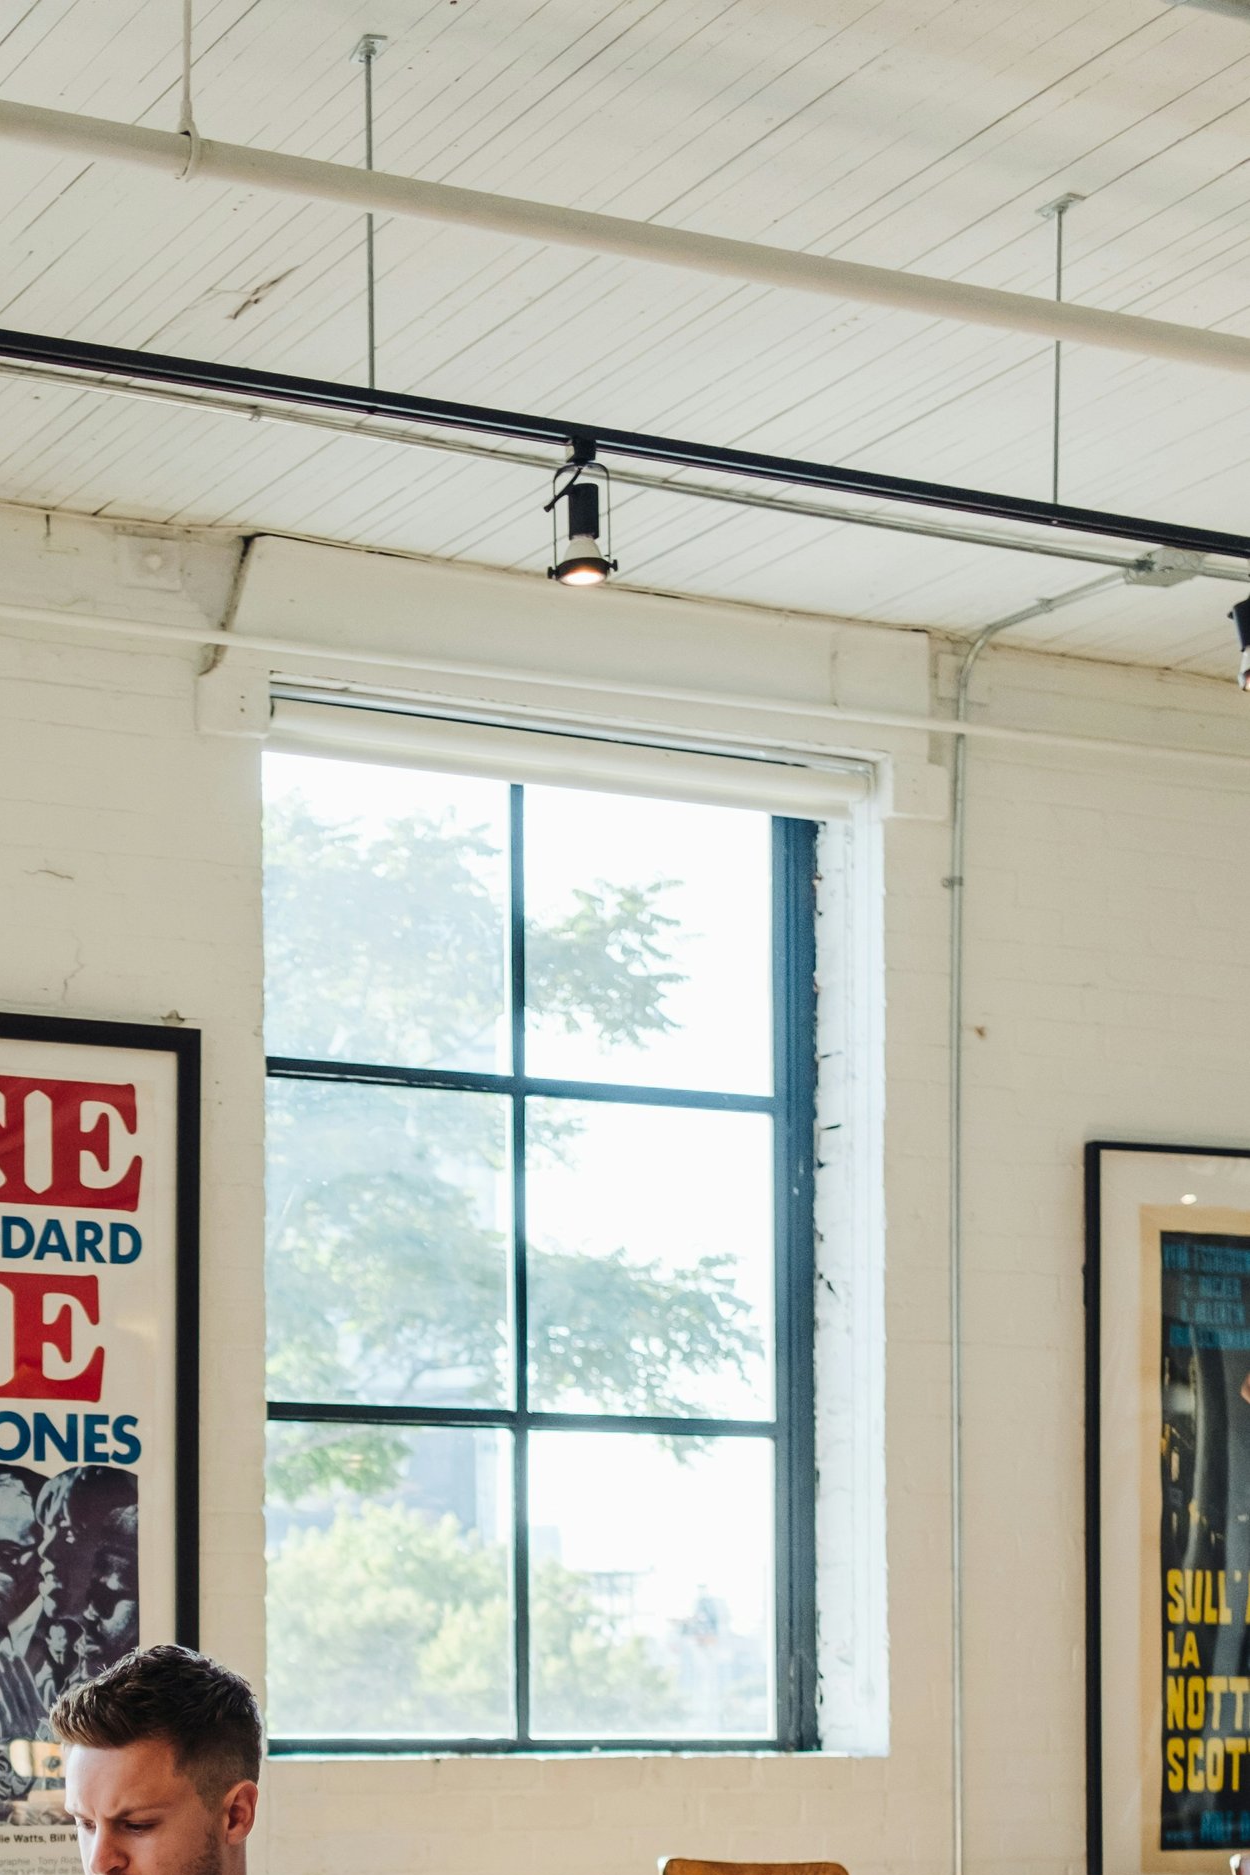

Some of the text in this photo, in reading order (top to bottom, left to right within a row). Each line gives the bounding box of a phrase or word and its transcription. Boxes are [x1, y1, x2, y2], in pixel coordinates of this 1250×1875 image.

[1166, 1569, 1250, 1625] SULL'
[1167, 1631, 1200, 1669] LA
[1166, 1675, 1250, 1731] NOTT
[1166, 1737, 1250, 1793] SCOT
[13, 1833, 47, 1844] Watts,
[50, 1832, 67, 1843] Bill
[56, 1866, 69, 1875] de
[60, 1855, 83, 1865] Rich
